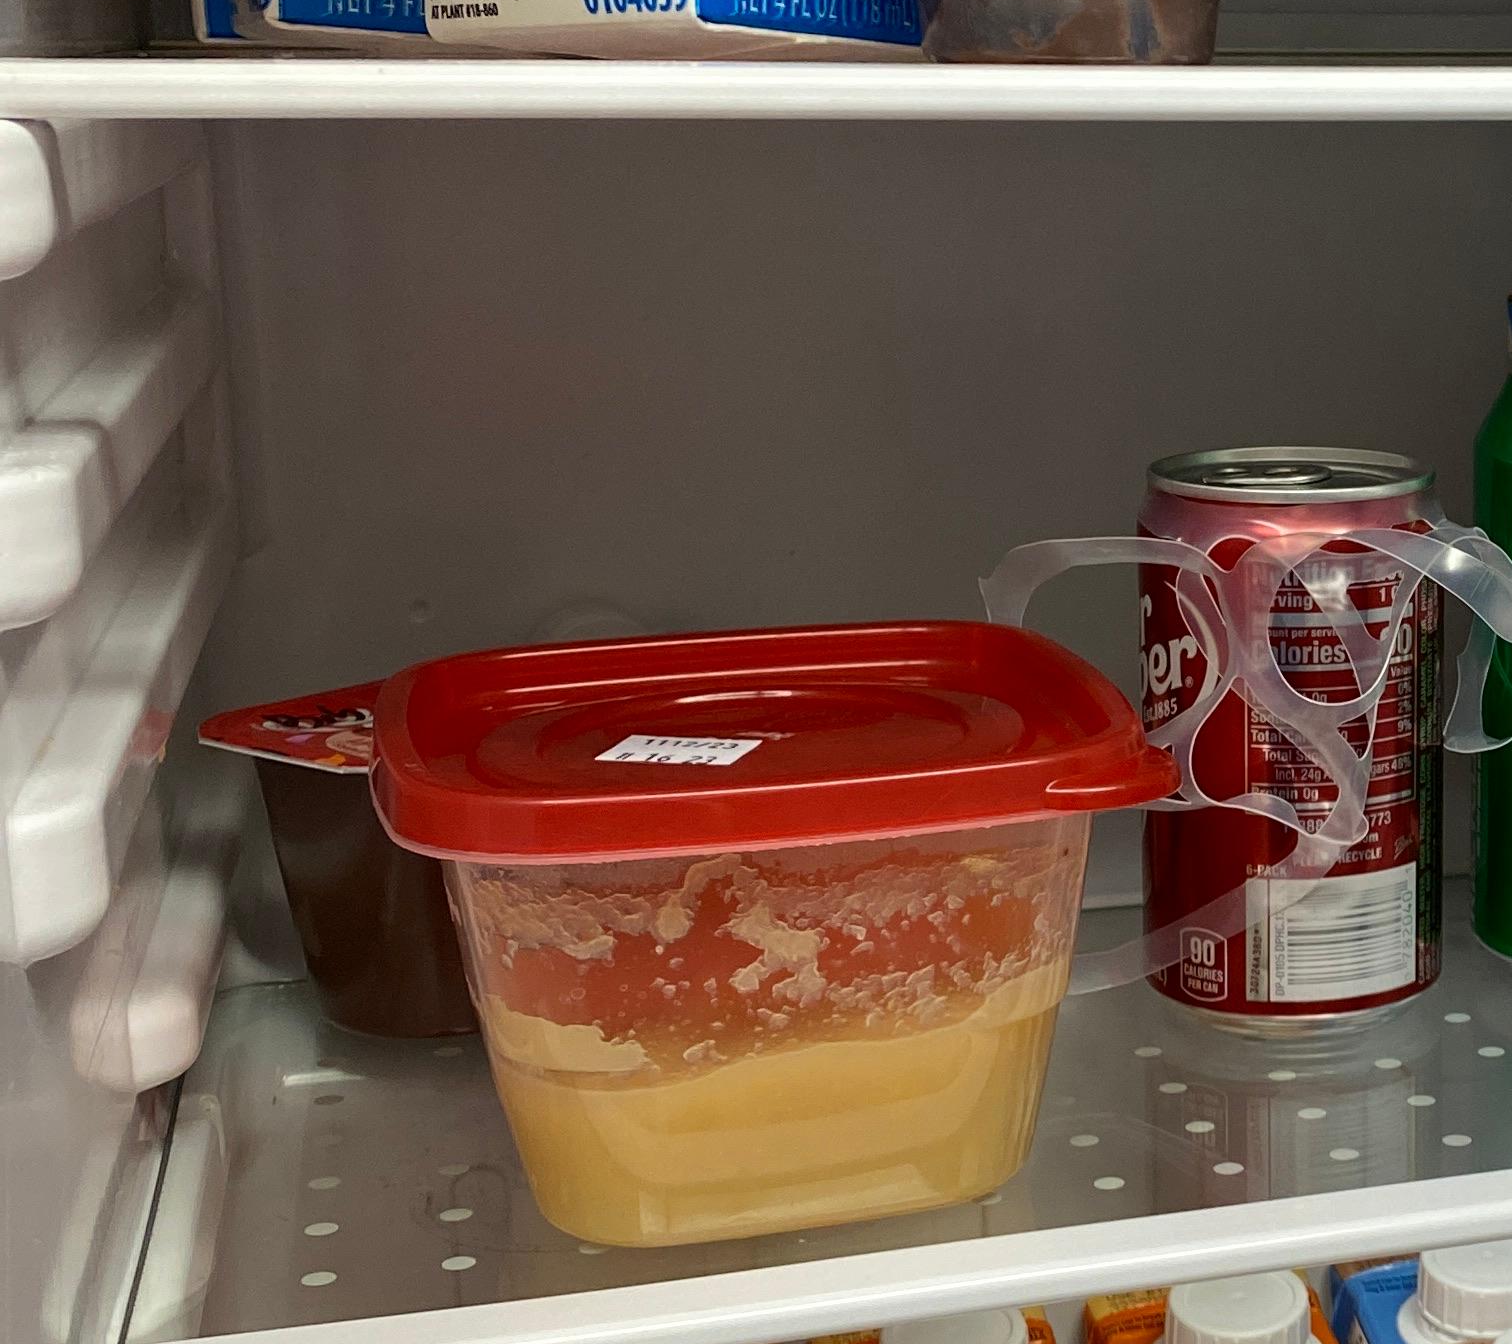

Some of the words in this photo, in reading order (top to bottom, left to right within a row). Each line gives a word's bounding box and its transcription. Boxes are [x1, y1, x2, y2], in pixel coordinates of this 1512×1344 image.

[1338, 847, 1383, 865] RECYCLE
[1189, 937, 1216, 966] 90
[1183, 963, 1225, 984] CALORIES
[1187, 978, 1201, 993] PER
[1201, 979, 1219, 994] CAN
